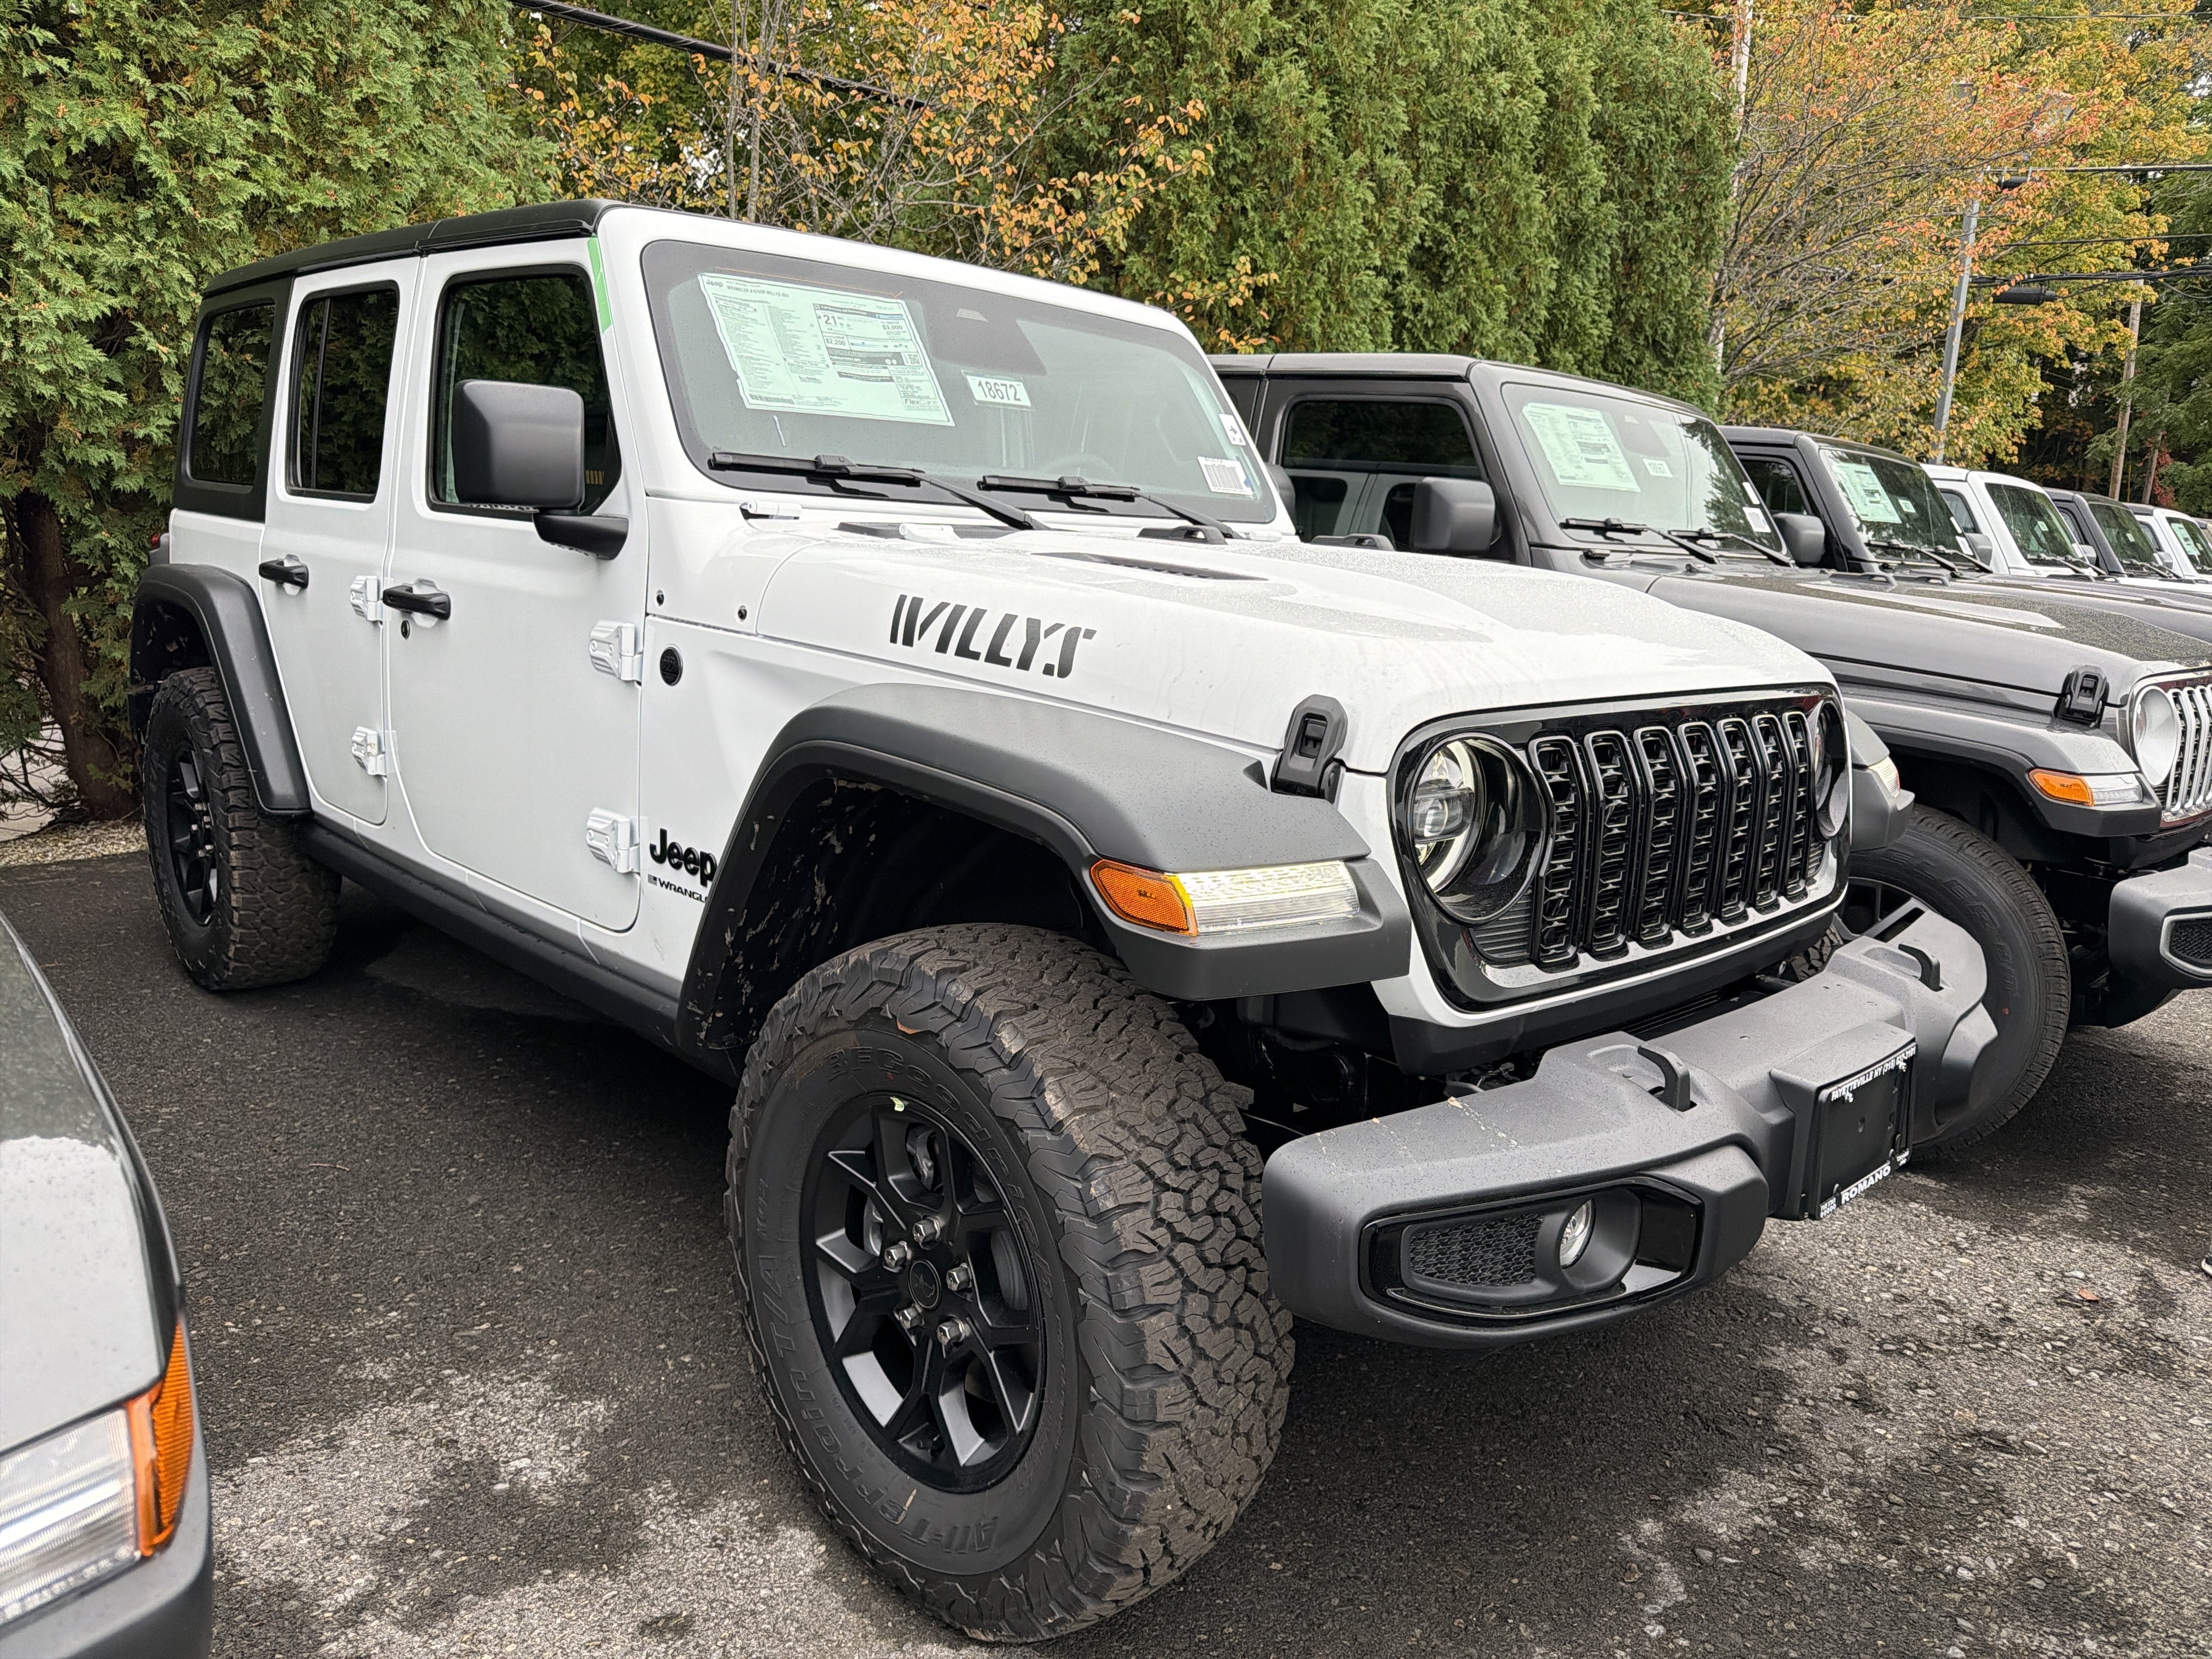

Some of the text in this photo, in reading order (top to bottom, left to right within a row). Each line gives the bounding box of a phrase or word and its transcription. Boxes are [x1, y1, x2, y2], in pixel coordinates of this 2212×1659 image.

[706, 279, 723, 288] Jeep
[823, 314, 837, 325] 21
[826, 338, 846, 346] $2,200
[978, 380, 1022, 402] 18672
[889, 594, 1097, 679] WILLYS
[650, 828, 717, 888] Jeep
[1831, 1071, 1874, 1102] FAYETTEVILLE
[1873, 1066, 1882, 1079] NY
[1842, 1165, 1892, 1204] ROMANO
